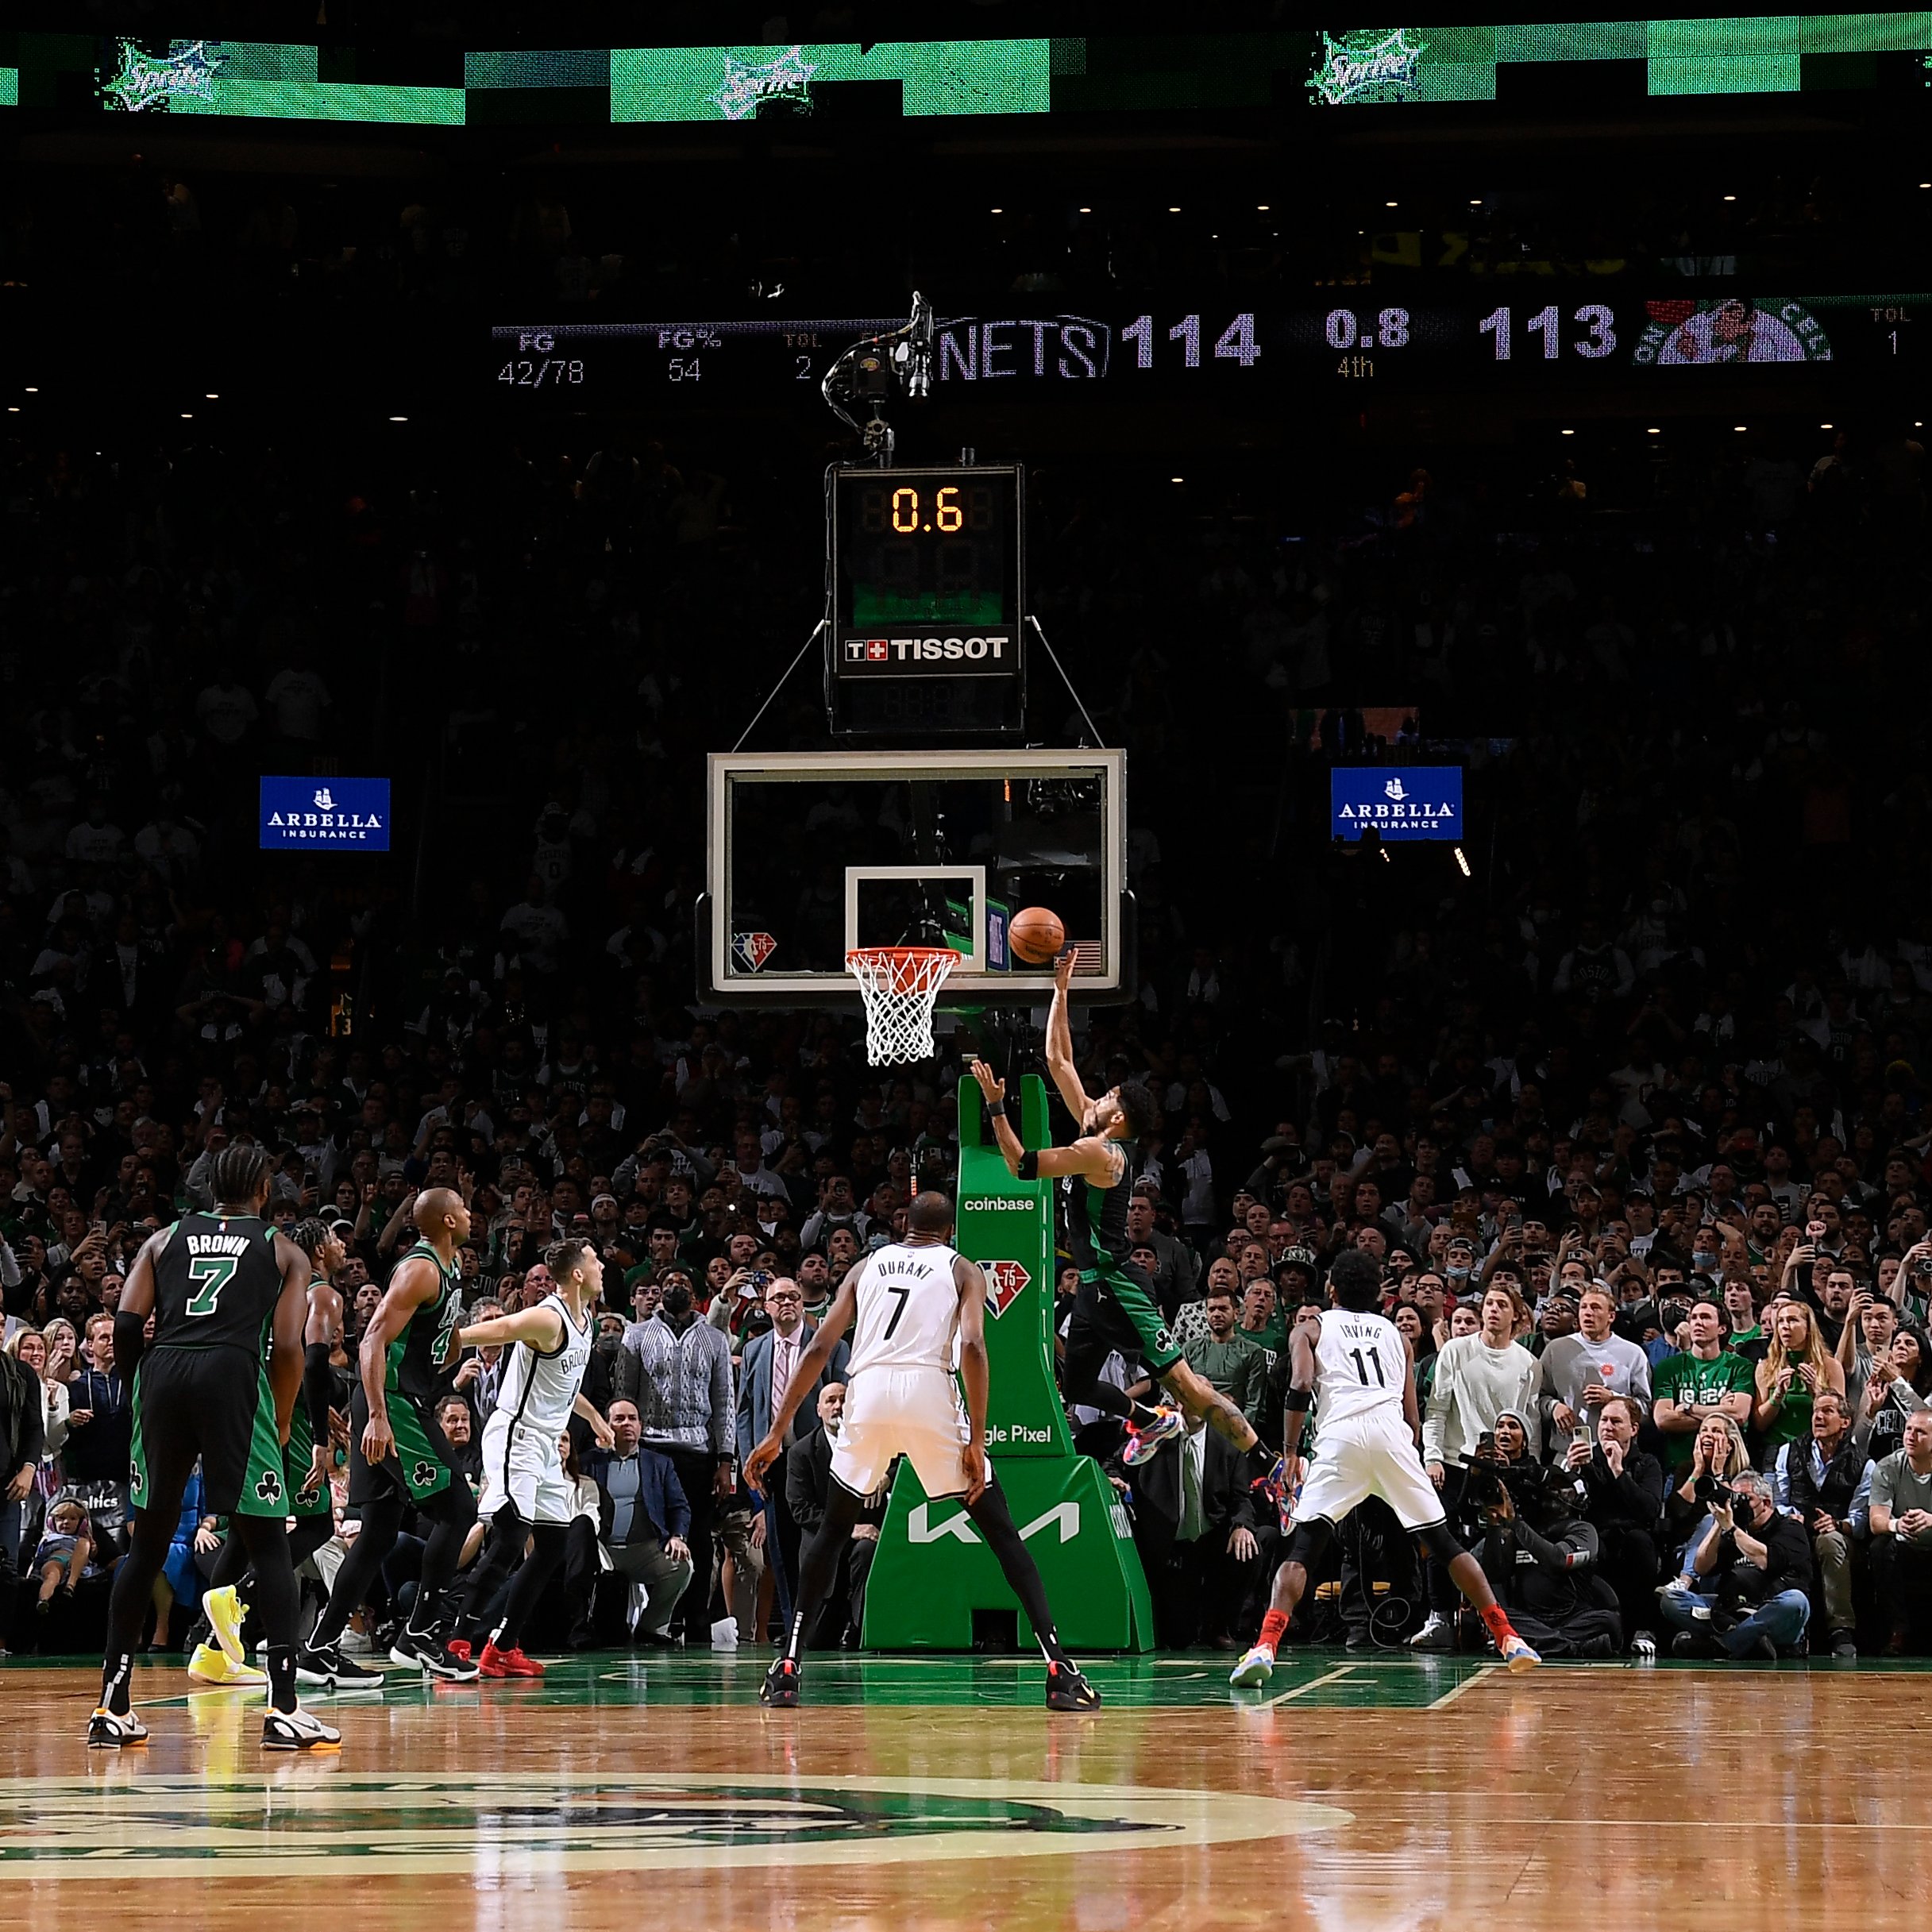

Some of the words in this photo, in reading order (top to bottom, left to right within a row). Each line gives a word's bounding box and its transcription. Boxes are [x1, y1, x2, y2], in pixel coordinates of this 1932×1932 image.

[1325, 308, 1410, 348] 0.8
[1479, 305, 1617, 361] 113
[519, 334, 554, 351] FG
[658, 331, 721, 349] FG%
[940, 320, 1099, 380] NETS
[1121, 313, 1261, 368] 114
[1888, 330, 1899, 355] 1
[499, 358, 584, 388] 42/78
[669, 358, 702, 381] 54
[796, 356, 811, 379] 2
[1337, 355, 1375, 378] 4th
[893, 487, 962, 532] 0.6
[890, 637, 1009, 661] TISSOT
[268, 812, 382, 828] ARBELLA
[1338, 802, 1455, 818] ARBELLA
[283, 830, 367, 839] INSURANCE
[1354, 820, 1439, 829] INSURANCE
[964, 1196, 1035, 1211] coinbase
[187, 1235, 251, 1257] BROWN
[877, 1260, 935, 1281] DURANT
[1003, 1269, 1016, 1287] 75
[186, 1256, 238, 1316] 7
[883, 1286, 911, 1341] 7
[1340, 1324, 1382, 1340] IRVING
[430, 1328, 449, 1365] 4
[1349, 1347, 1386, 1389] 11
[984, 1424, 1008, 1447] gle
[1012, 1425, 1051, 1443] Pixel
[81, 1494, 118, 1509] eltics
